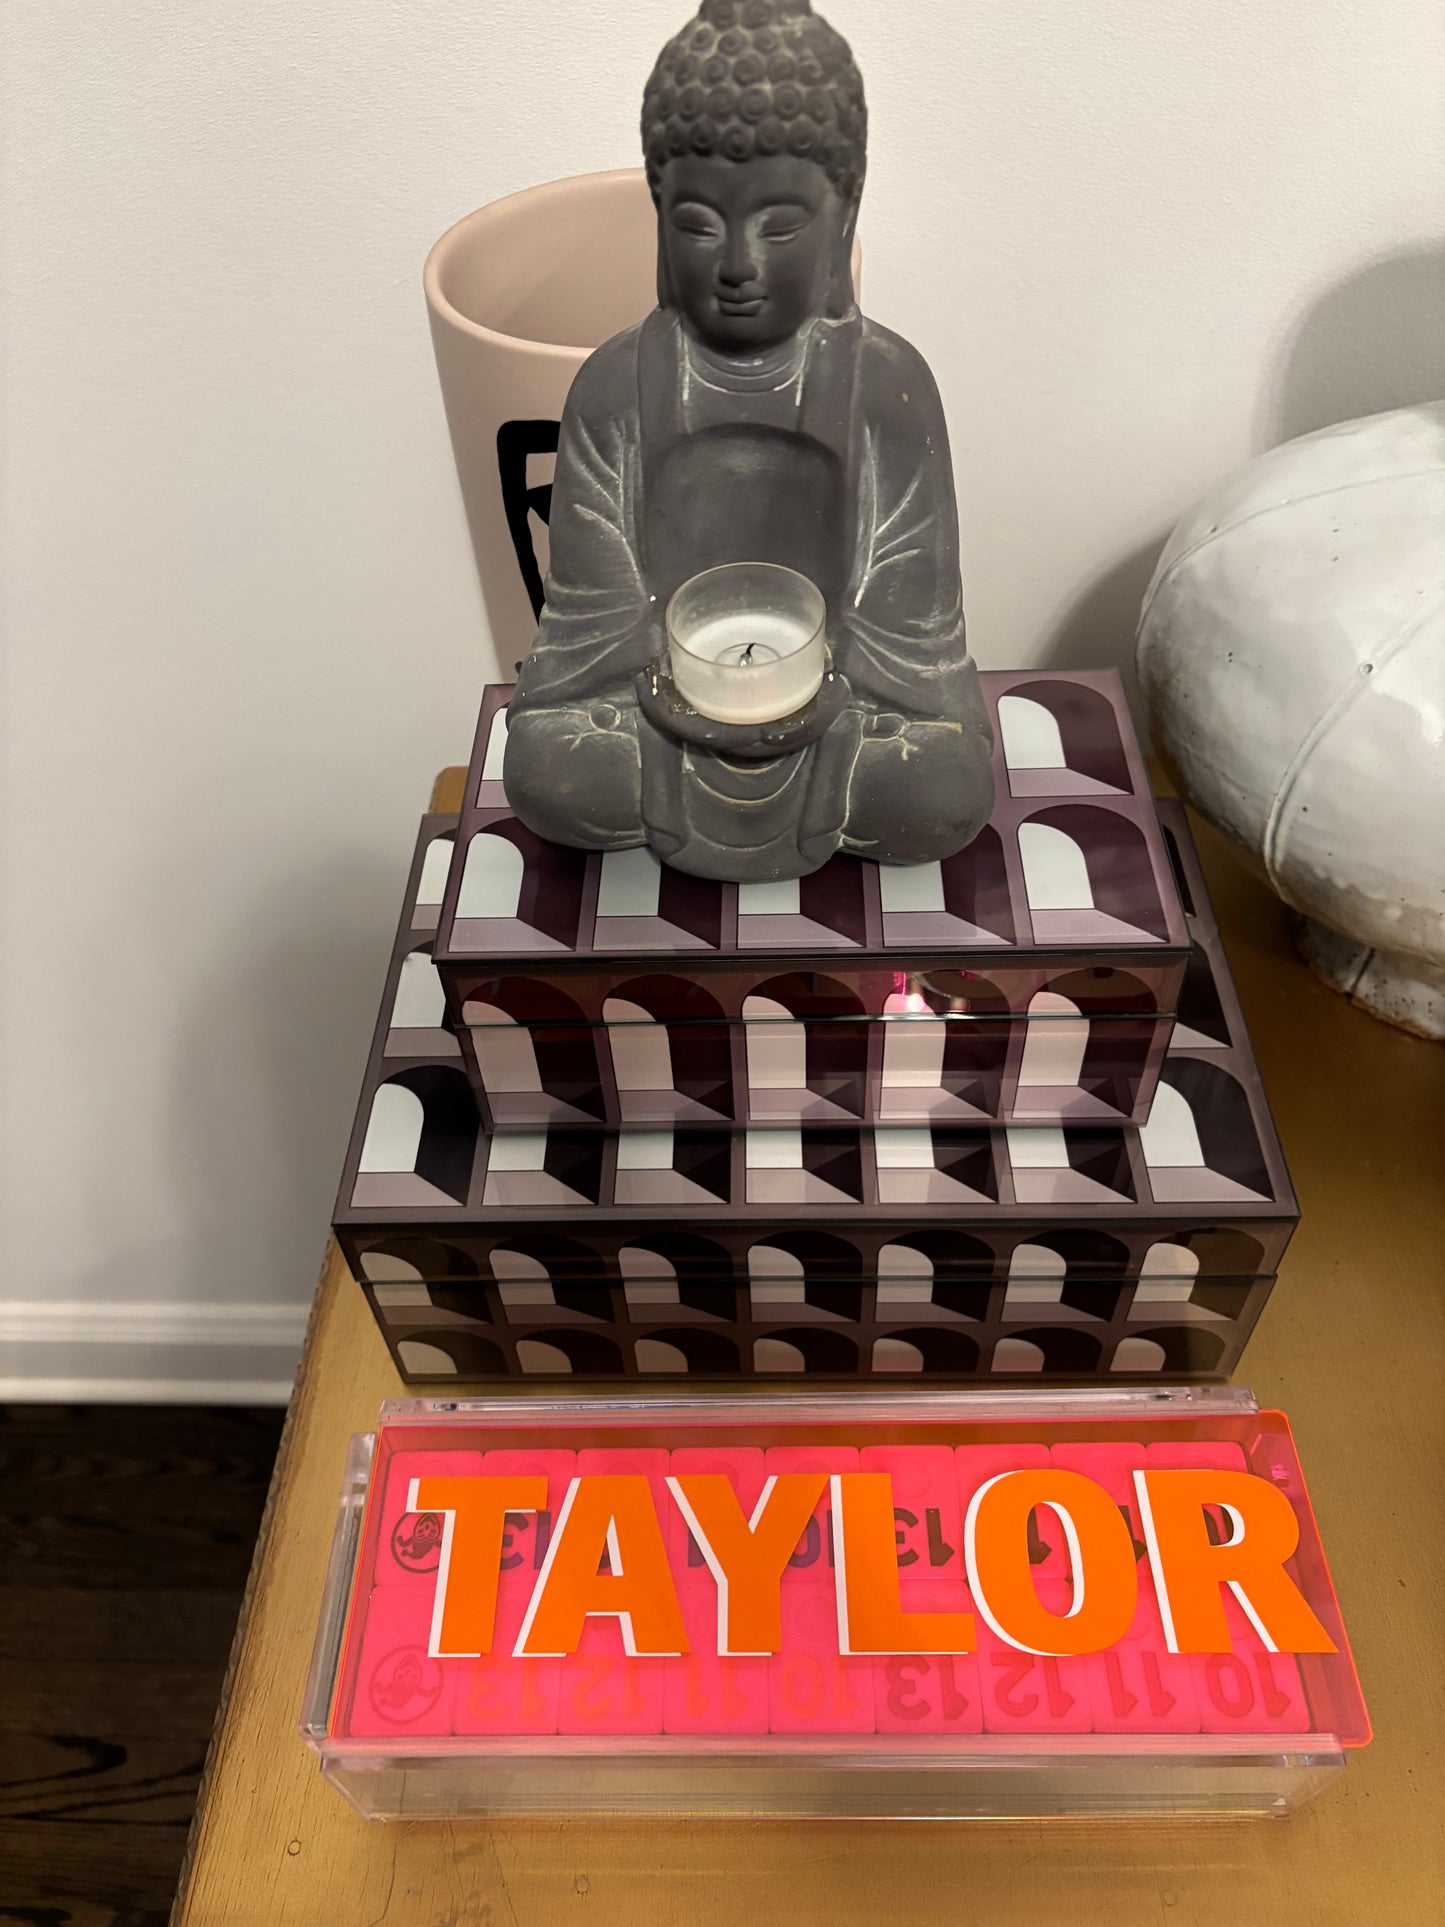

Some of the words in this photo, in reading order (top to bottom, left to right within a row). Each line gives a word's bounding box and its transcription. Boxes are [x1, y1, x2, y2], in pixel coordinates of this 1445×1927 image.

[406, 1468, 1339, 1657] TAYLOR
[883, 1654, 969, 1721] 13
[991, 1652, 1075, 1718] 12
[1099, 1652, 1177, 1717] 11
[1203, 1652, 1292, 1718] 10
